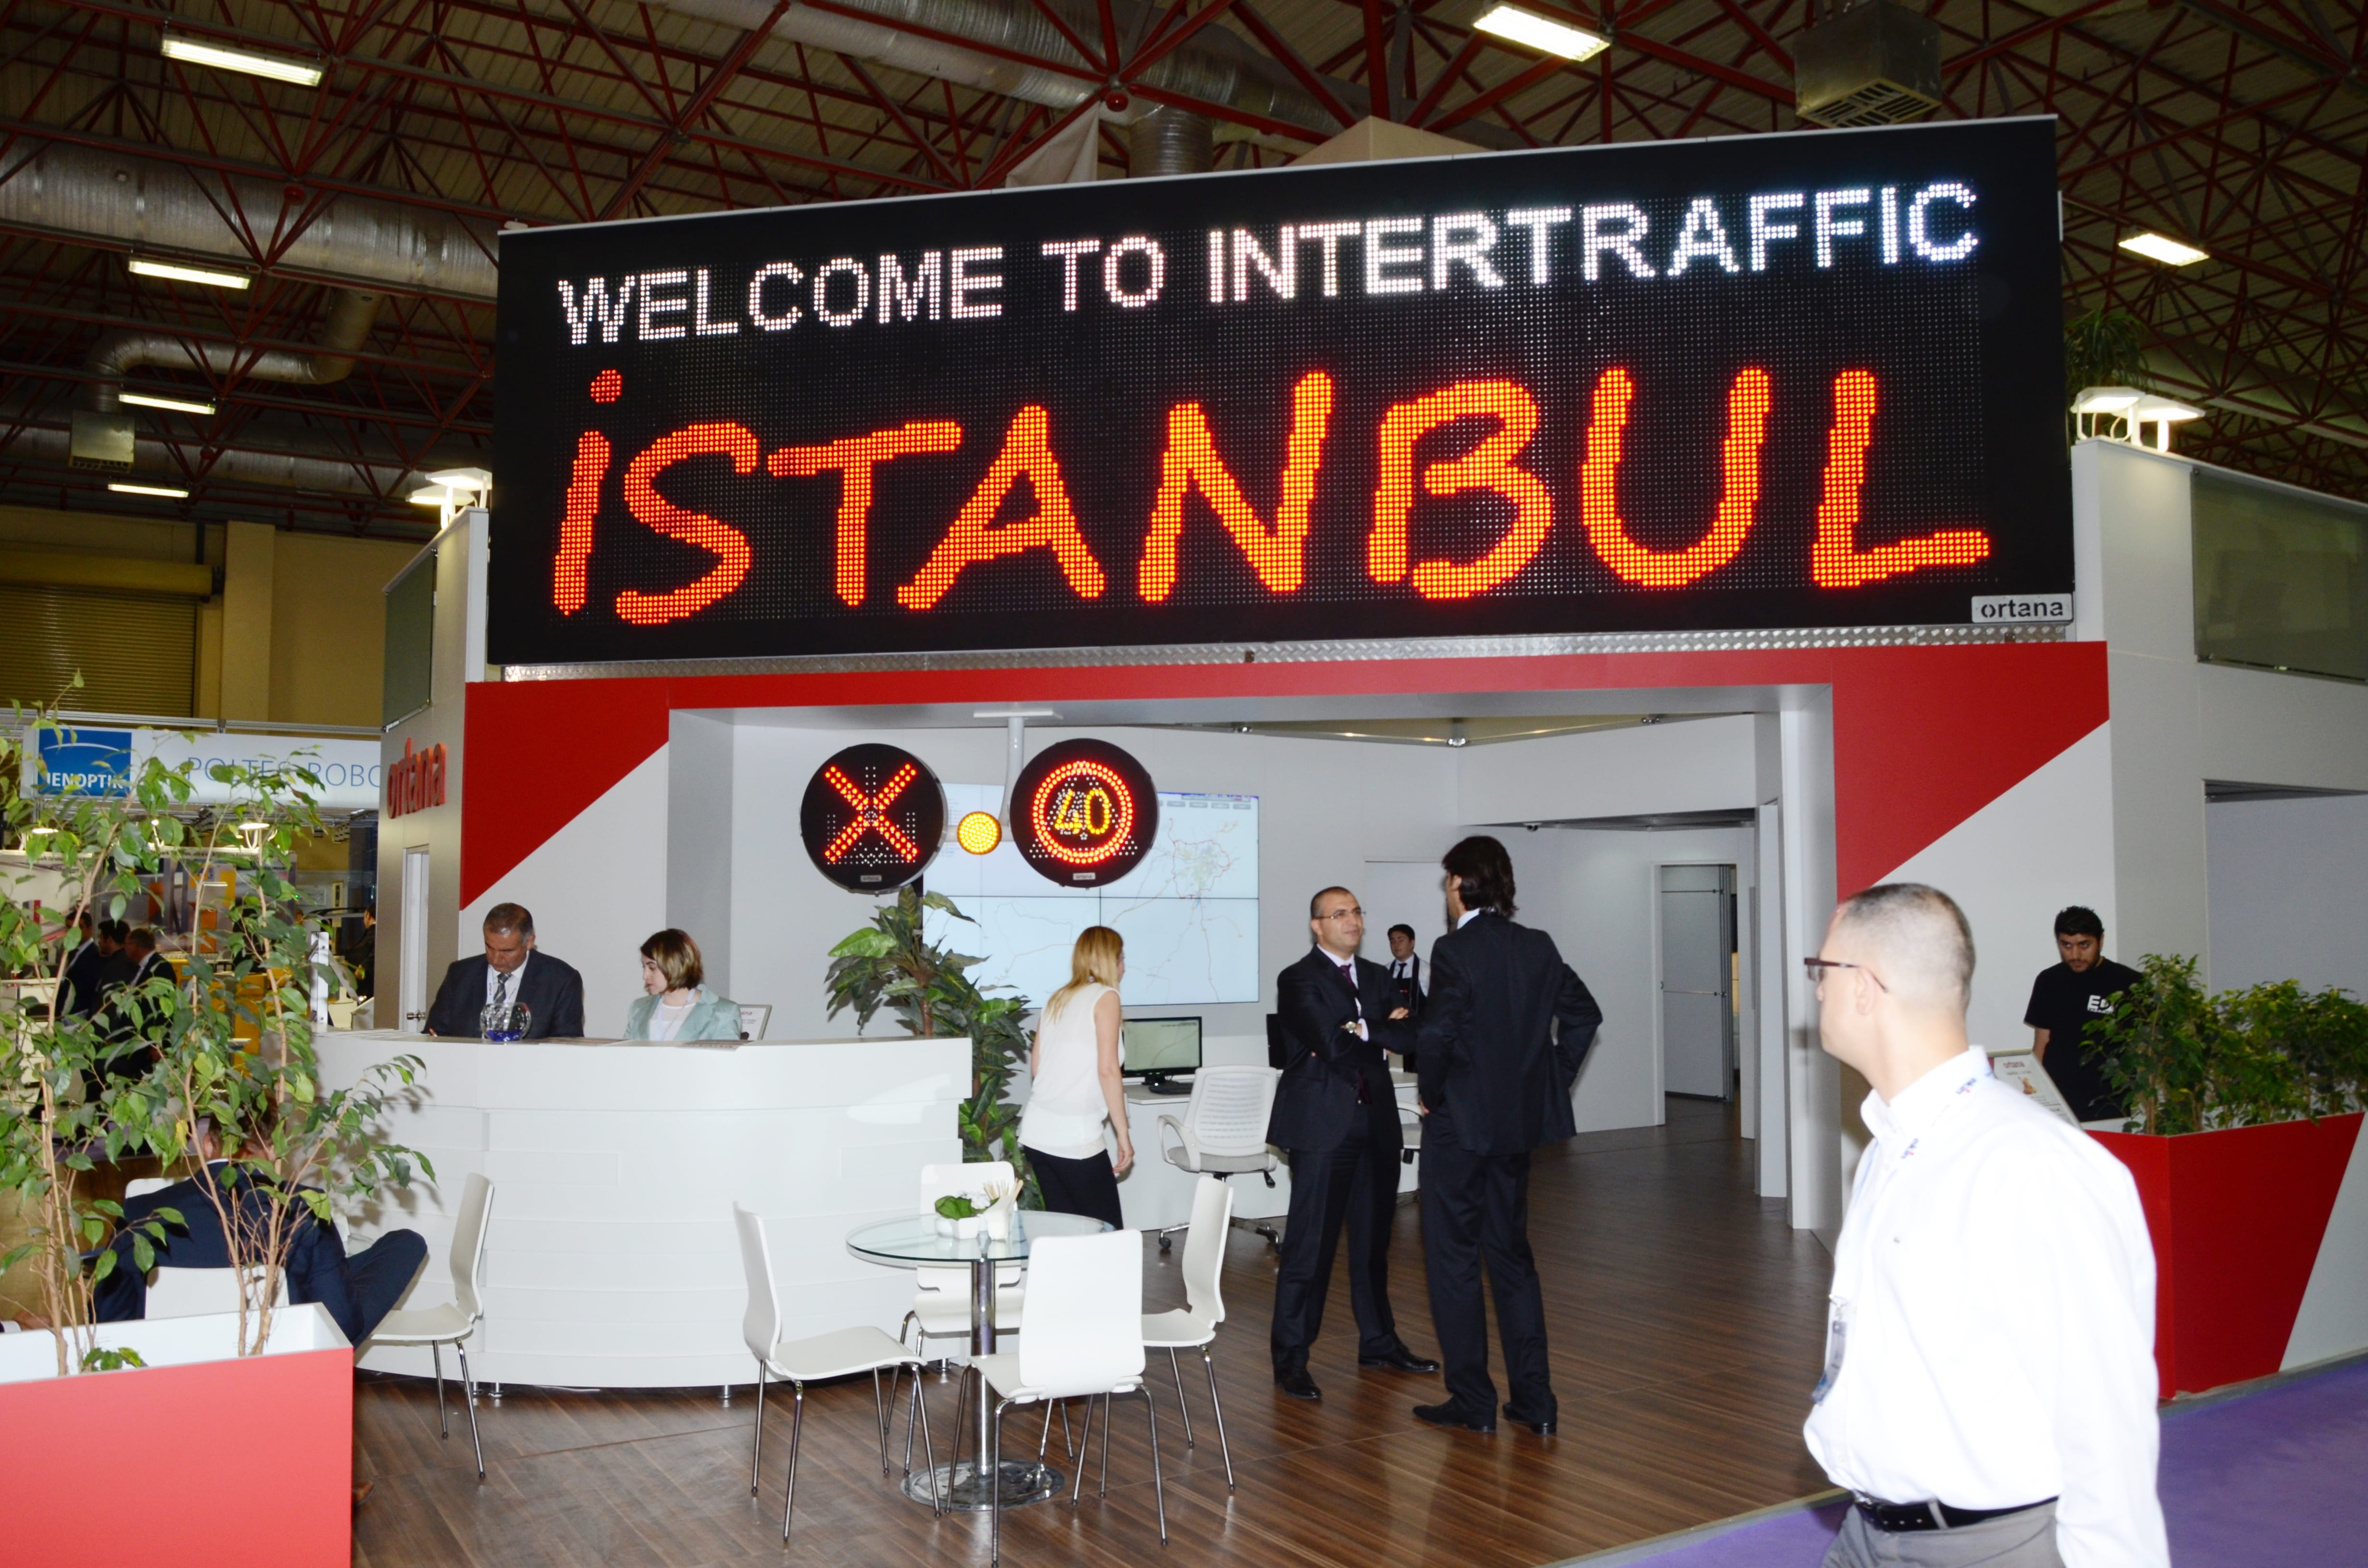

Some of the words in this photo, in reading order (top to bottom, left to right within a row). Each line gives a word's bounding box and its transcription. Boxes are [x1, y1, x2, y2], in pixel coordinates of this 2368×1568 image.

[558, 247, 1003, 345] WELCOME
[1042, 236, 1164, 310] TO
[1209, 183, 1978, 303] INTERTRAFFIC
[1981, 600, 2063, 618] ortana
[387, 737, 446, 819] ortana
[1054, 789, 1110, 834] 40
